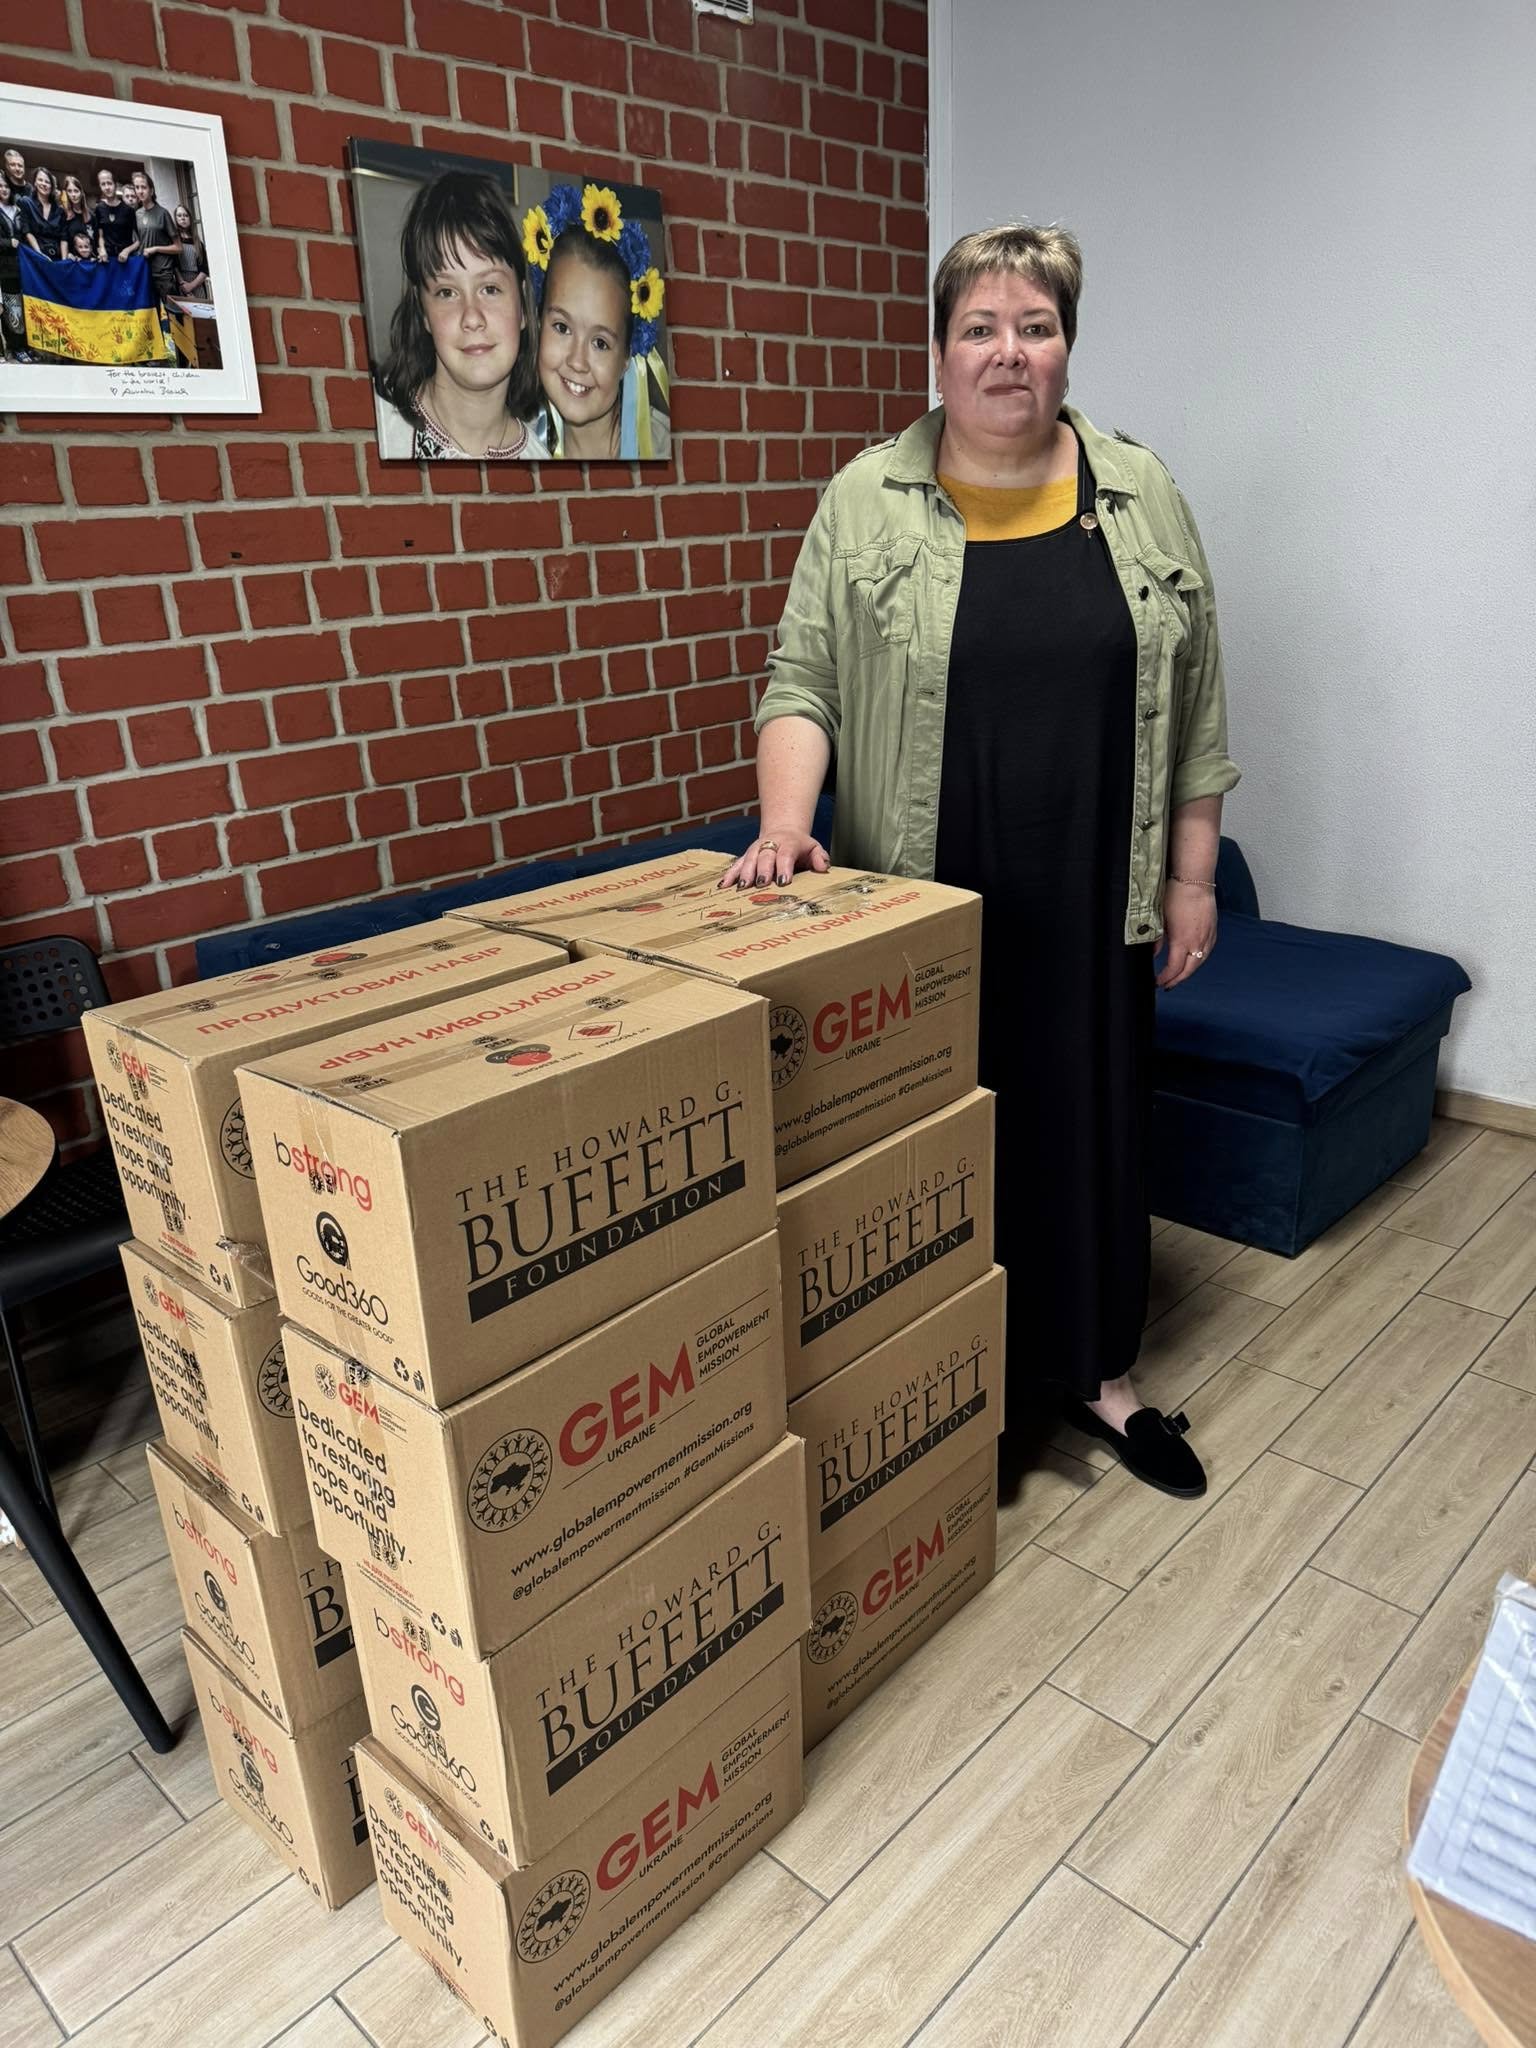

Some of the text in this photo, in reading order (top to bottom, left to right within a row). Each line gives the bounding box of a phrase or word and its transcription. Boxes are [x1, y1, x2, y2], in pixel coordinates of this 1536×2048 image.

[106, 369, 120, 378] For
[501, 861, 699, 917] ПРОДУКТОВИЙ НАБІР
[717, 891, 921, 960] ПРОДУКТОВИЙ НАБІР
[197, 946, 502, 1035] ПРОДУКТОВИЙ НАБІР
[812, 974, 911, 1054] GEM
[914, 990, 946, 1010] MISSION
[915, 965, 944, 982] GLOBAL
[915, 966, 972, 996] EMPOWERMENT
[319, 970, 617, 1070] ПРОДУКТОВИЙ НАБІР
[845, 1037, 881, 1060] UKRAINE
[101, 1084, 162, 1133] Dedicated
[122, 1052, 150, 1081] GEM
[774, 1046, 953, 1134] www.globalempowermentmission.org
[107, 1109, 173, 1166] to restoring
[455, 1080, 742, 1213] THE HOWARD G.
[774, 1065, 953, 1157] @globalempowermentmission #GemMissions
[115, 1134, 170, 1184] hope and
[121, 1166, 191, 1220] opportunity.
[273, 1132, 372, 1211] bstrong
[459, 1101, 743, 1285] BUFFETT
[504, 1175, 724, 1300] FOUNDATION
[798, 1157, 975, 1267] THE HOWARD G.
[798, 1172, 975, 1319] BUFFETT
[159, 1291, 188, 1325] GEM
[296, 1255, 389, 1325] Good360
[822, 1230, 961, 1329] FOUNDATION
[138, 1309, 200, 1374] Dedicated
[143, 1332, 207, 1401] to restoring
[696, 1318, 735, 1348] GLOBAL
[697, 1308, 770, 1364] EMPOWERMENT
[699, 1344, 740, 1378] MISSION
[148, 1355, 204, 1415] hope and
[156, 1382, 224, 1451] opportunity.
[337, 1382, 380, 1425] GEM
[559, 1341, 695, 1467] GEM
[817, 1335, 988, 1457] THE HOWARD G.
[818, 1347, 988, 1507] BUFFETT
[298, 1398, 387, 1475] Dedicated
[302, 1425, 396, 1509] to restoring
[607, 1423, 657, 1463] UKRAINE
[841, 1402, 972, 1513] FOUNDATION
[307, 1450, 387, 1522] hope and
[312, 1481, 413, 1565] opportunity.
[511, 1401, 752, 1577] www.globalempowermentmission.org
[512, 1477, 681, 1601] @globalempowermentmission
[684, 1423, 754, 1478] #GemMissions
[172, 1502, 238, 1586] bstrong
[863, 1519, 945, 1616] GEM
[374, 1608, 465, 1706] bstrong
[536, 1521, 780, 1709] THE HOWARD G.
[539, 1533, 781, 1768] BUFFETT
[577, 1604, 763, 1768] FOUNDATION
[208, 1687, 278, 1774] bstrong
[391, 1704, 476, 1792] Good360
[721, 1728, 758, 1761] GLOBAL
[722, 1711, 790, 1775] EMPOWERMENT
[723, 1749, 762, 1786] MISSION
[369, 1804, 452, 1899] Dedicated
[405, 1811, 441, 1855] GEM
[596, 1759, 720, 1891] GEM
[639, 1835, 684, 1878] UKRAINE
[371, 1824, 385, 1848] to
[389, 1842, 454, 1925] restoring
[376, 1847, 446, 1932] hope and
[553, 1792, 773, 1993] www.globalempowermentmission.org
[554, 1871, 705, 2012] @globalempowermentmission
[707, 1808, 774, 1872] #GemMissions
[379, 1868, 468, 1973] opportunity.
